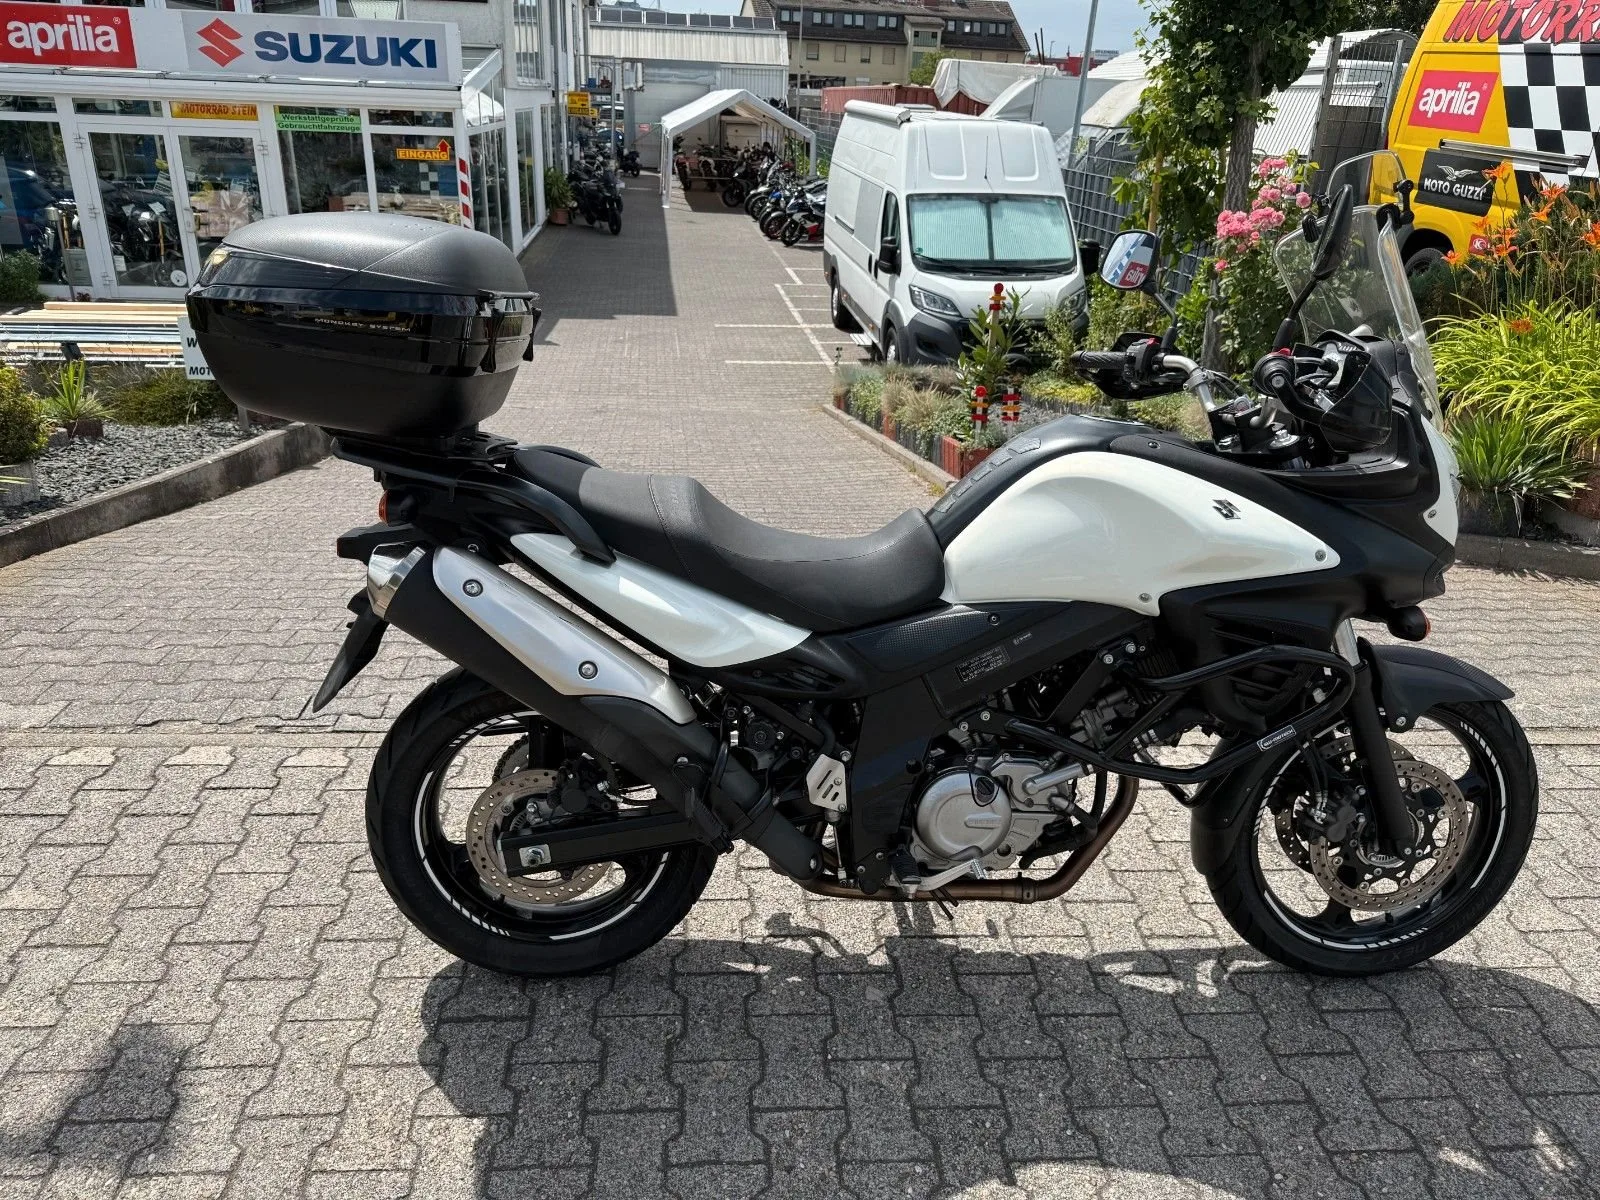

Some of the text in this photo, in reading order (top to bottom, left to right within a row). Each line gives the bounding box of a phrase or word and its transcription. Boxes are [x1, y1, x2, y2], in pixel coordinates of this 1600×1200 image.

[1443, 0, 1600, 45] MOTORR
[7, 14, 119, 56] aprilia
[254, 30, 437, 69] SUZUKI
[181, 102, 257, 116] MOTORRAD STEIN
[1418, 81, 1481, 118] aprilia
[278, 122, 361, 132] Gebrauchtfahrzeuge
[282, 114, 355, 124] Werkstattgeprüfte
[399, 150, 448, 160] EINGANG
[1424, 177, 1483, 201] MOTO GUZZI
[369, 323, 411, 333] SYSTEM
